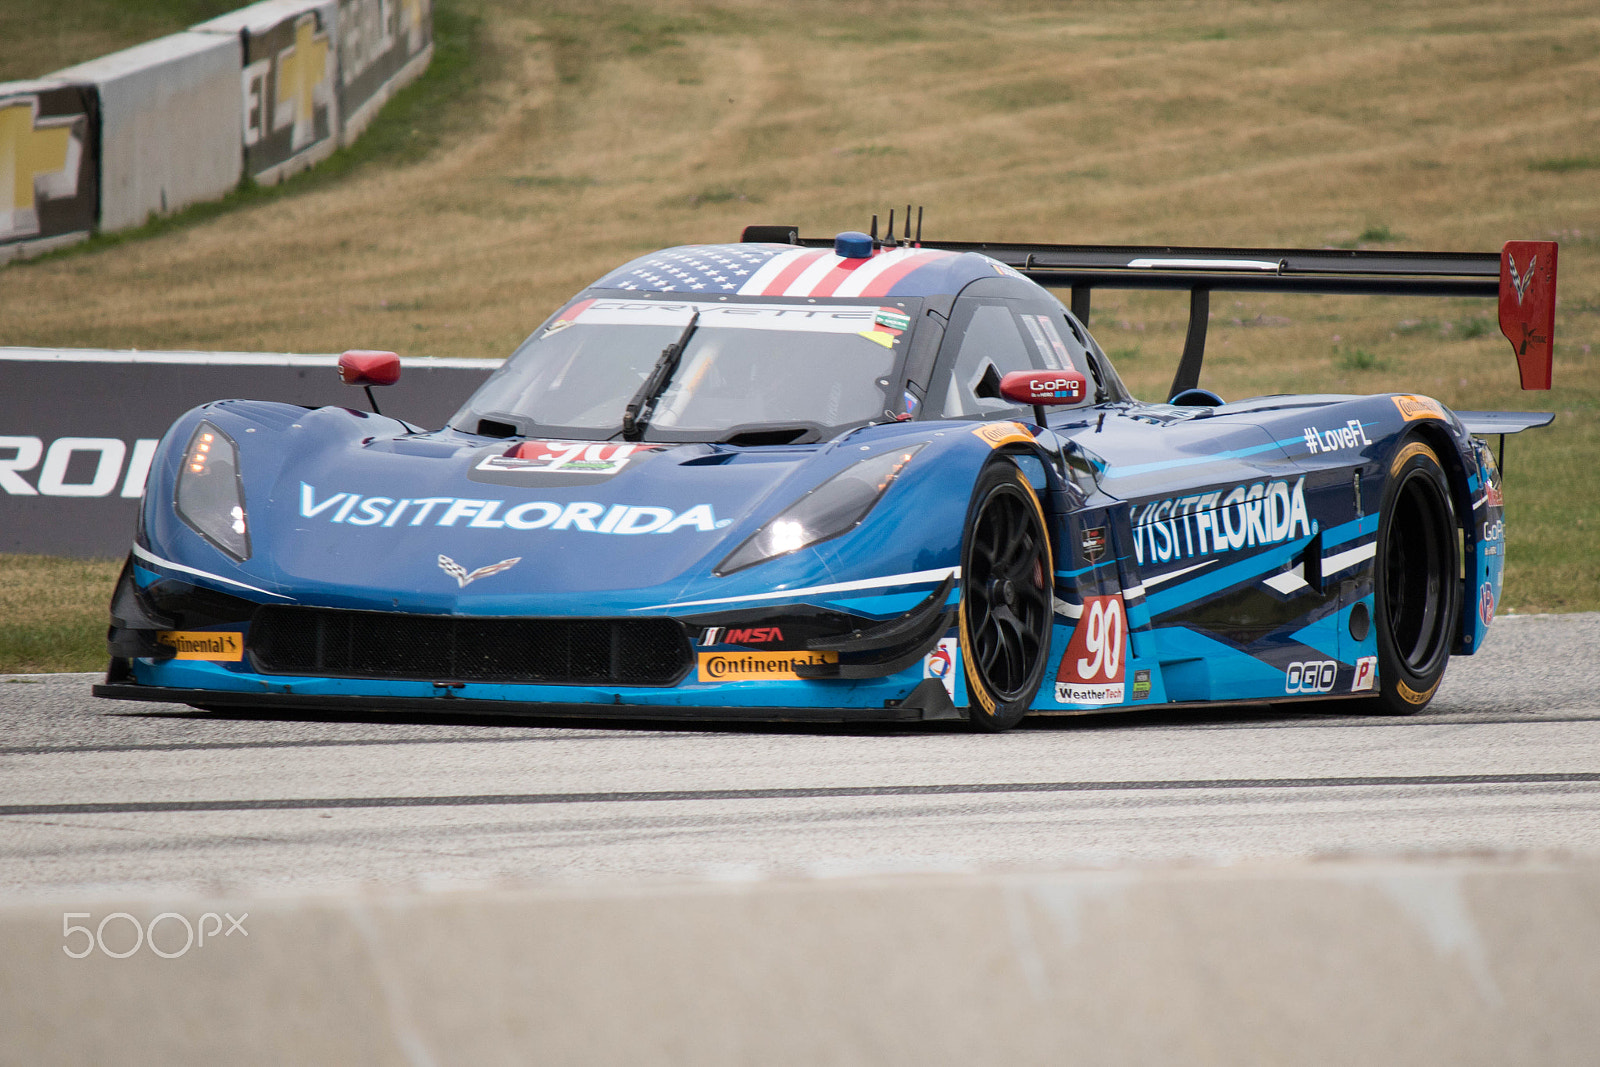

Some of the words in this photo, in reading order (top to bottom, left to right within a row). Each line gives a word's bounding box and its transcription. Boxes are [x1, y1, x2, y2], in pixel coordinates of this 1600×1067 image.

[589, 302, 873, 319] CORVETTE
[1030, 379, 1079, 391] GoPro
[1303, 419, 1372, 454] #LoveFL
[724, 627, 784, 644] IMSA
[1077, 599, 1122, 680] 90
[1285, 660, 1338, 694] OGIO
[1059, 687, 1122, 700] WeatherTech
